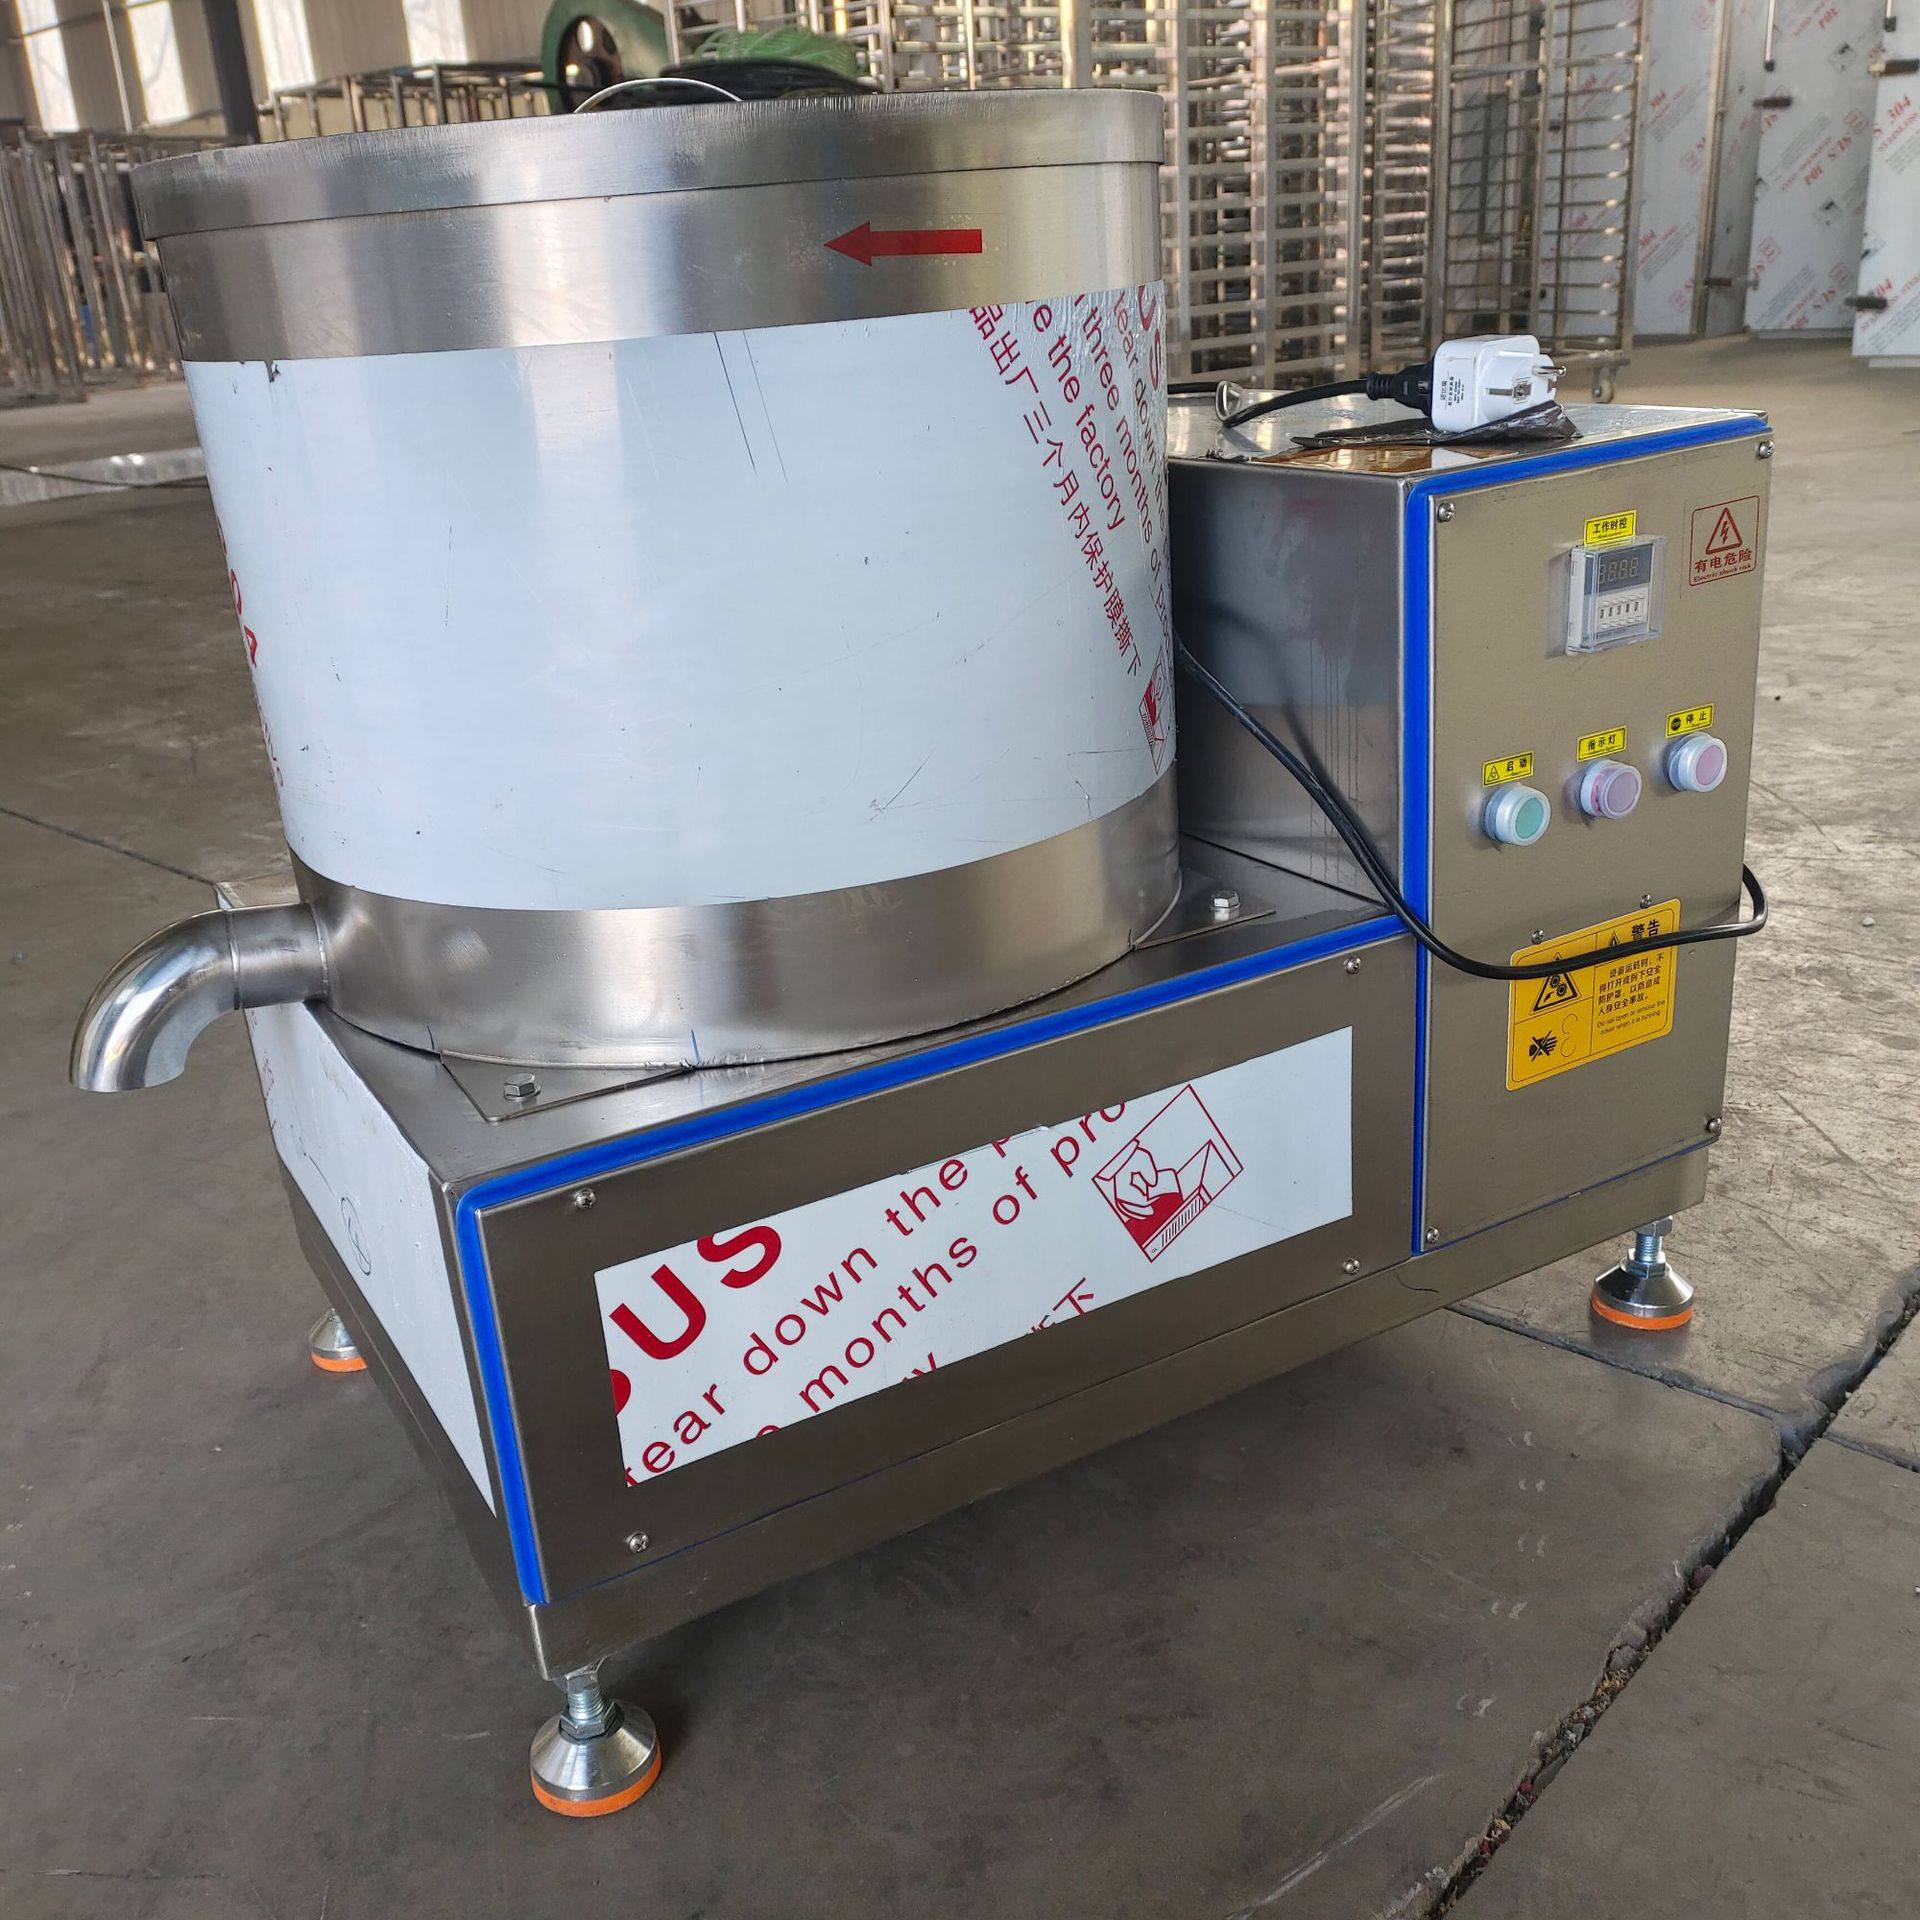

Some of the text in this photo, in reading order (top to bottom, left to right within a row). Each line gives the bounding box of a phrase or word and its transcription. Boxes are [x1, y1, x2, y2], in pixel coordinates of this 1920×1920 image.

[1048, 333, 1080, 404] the
[1076, 403, 1126, 531] factory
[1082, 305, 1120, 412] three
[1116, 415, 1153, 544] months
[1694, 548, 1752, 574] 有电危险
[743, 1243, 878, 1376] down
[885, 1159, 969, 1237] the
[799, 1236, 978, 1414] months
[992, 1165, 1038, 1226] of
